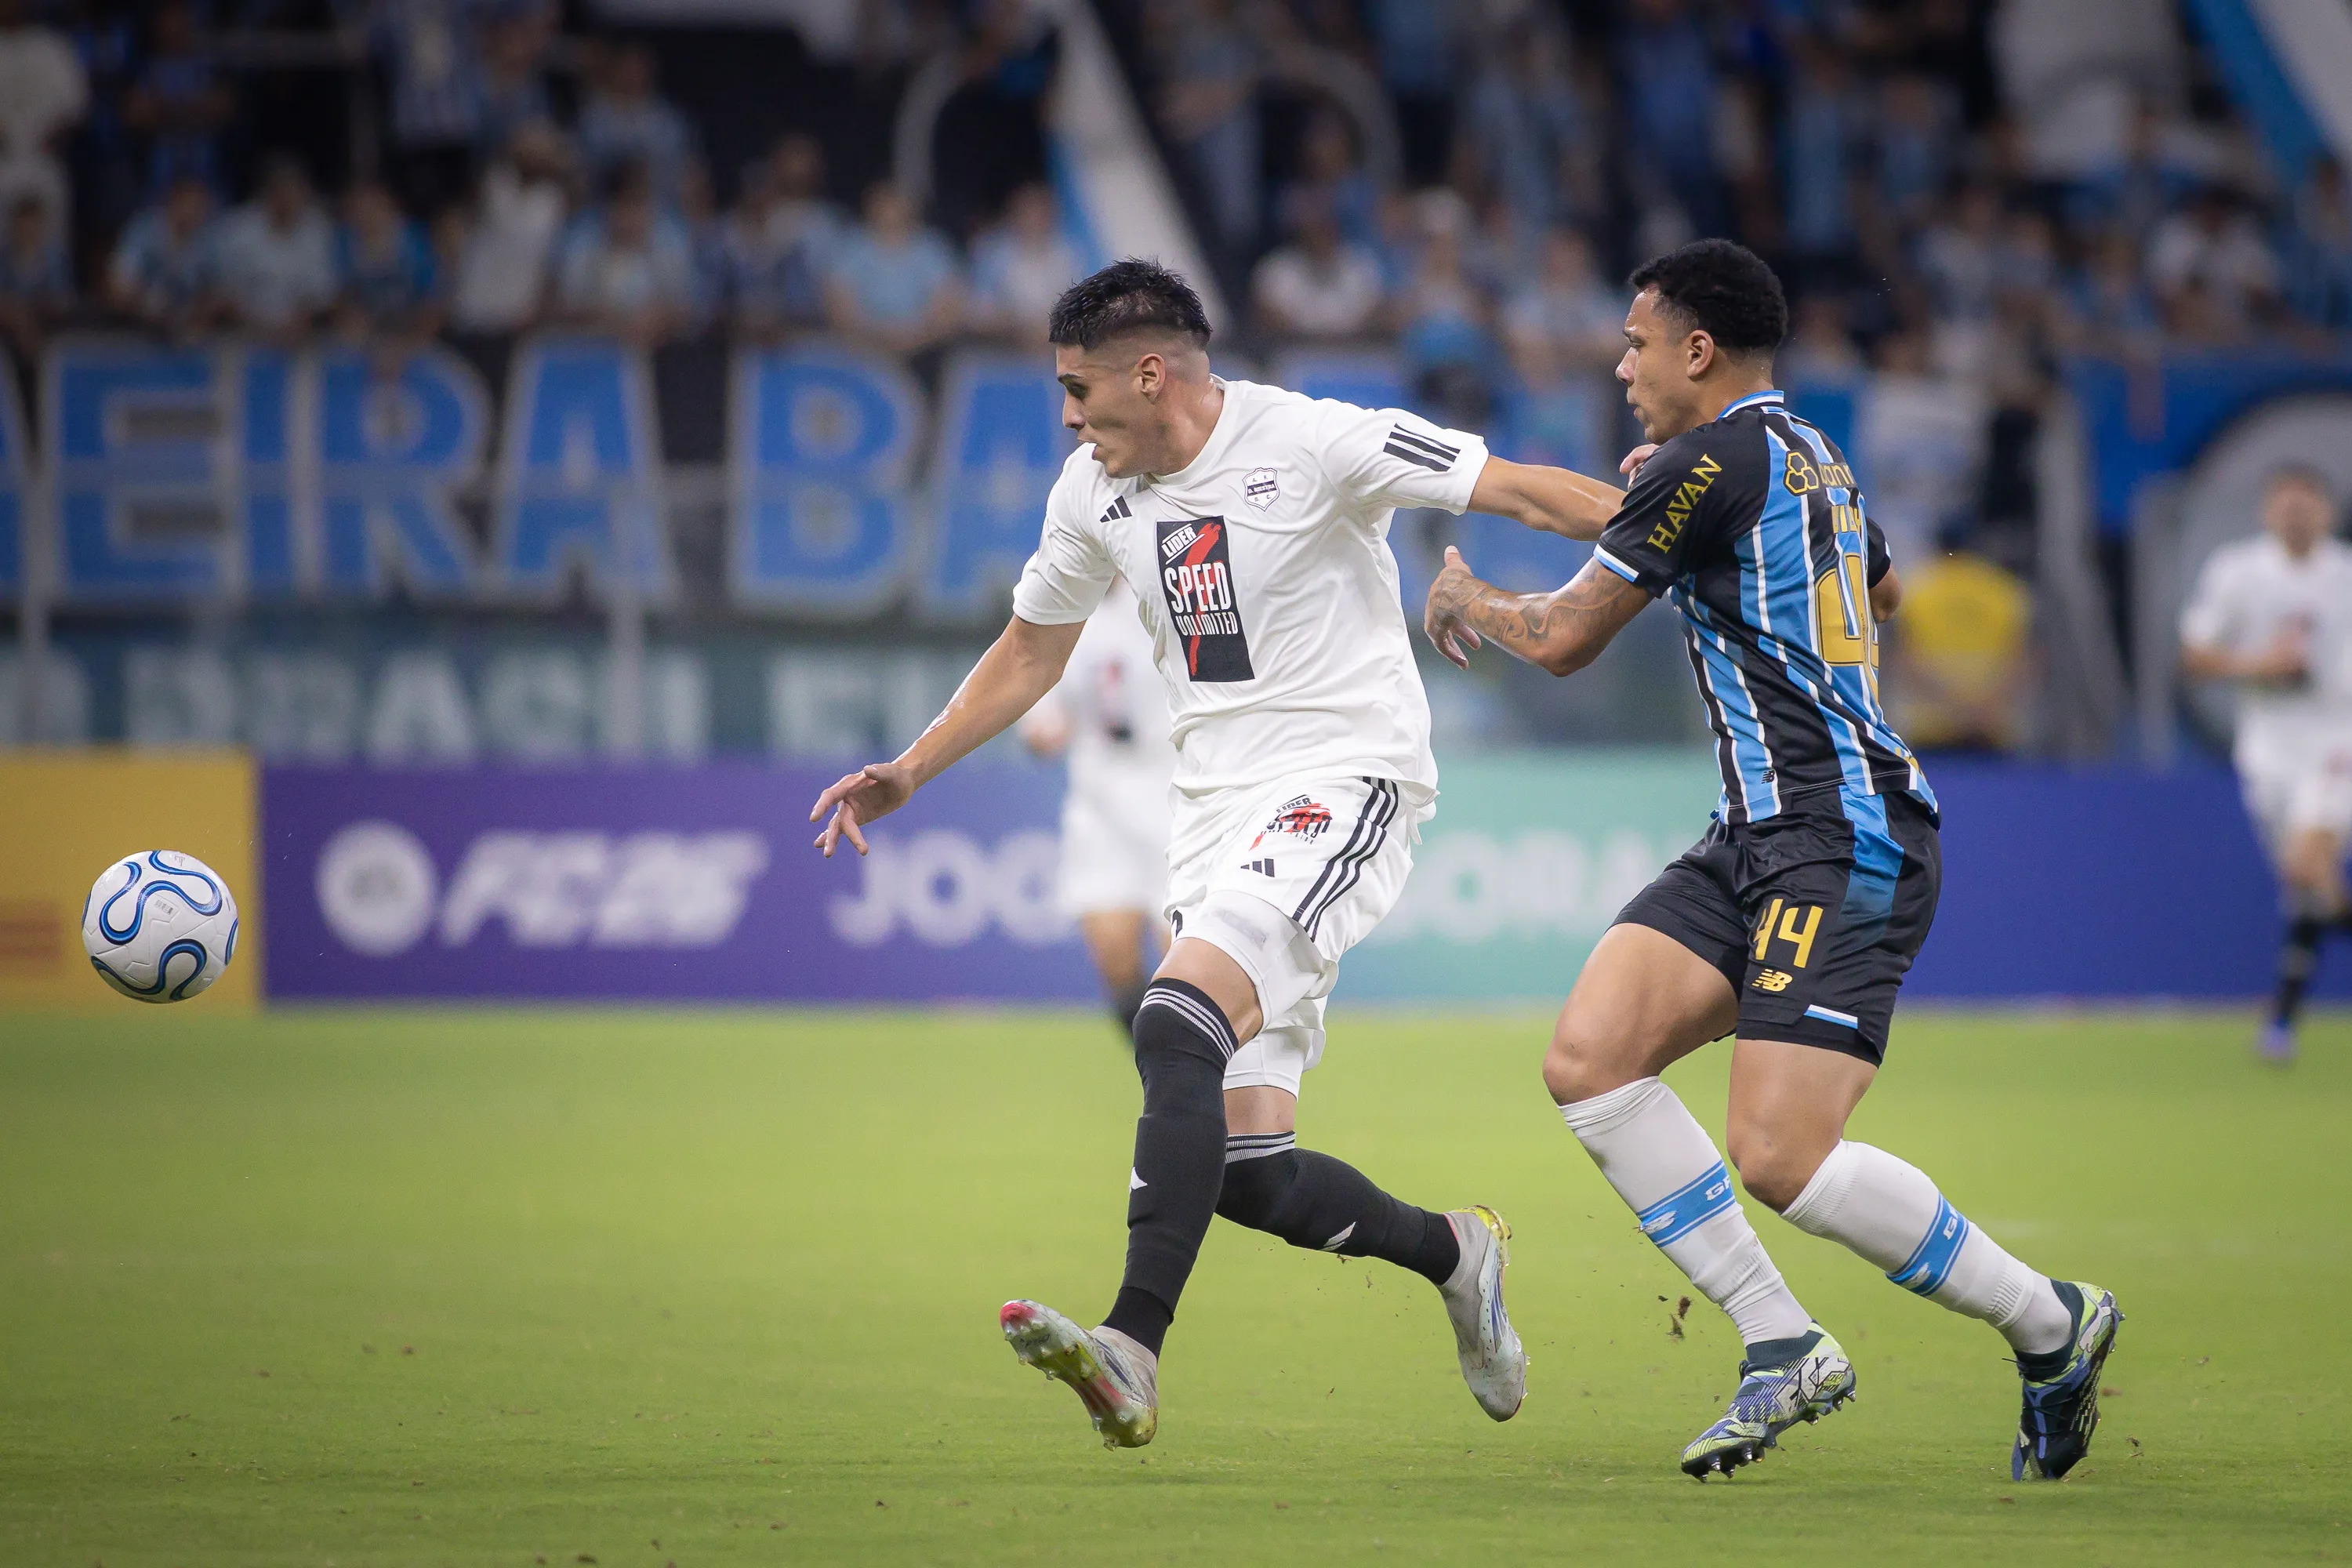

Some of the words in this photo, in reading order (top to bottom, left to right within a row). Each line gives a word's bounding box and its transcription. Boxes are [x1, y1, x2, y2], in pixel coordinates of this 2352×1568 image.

[1647, 453, 1722, 554] HAVAN
[1161, 525, 1197, 558] LIDER
[1164, 561, 1232, 614] SPEED
[1175, 611, 1239, 637] UNLIMITED
[1754, 898, 1824, 968] 44
